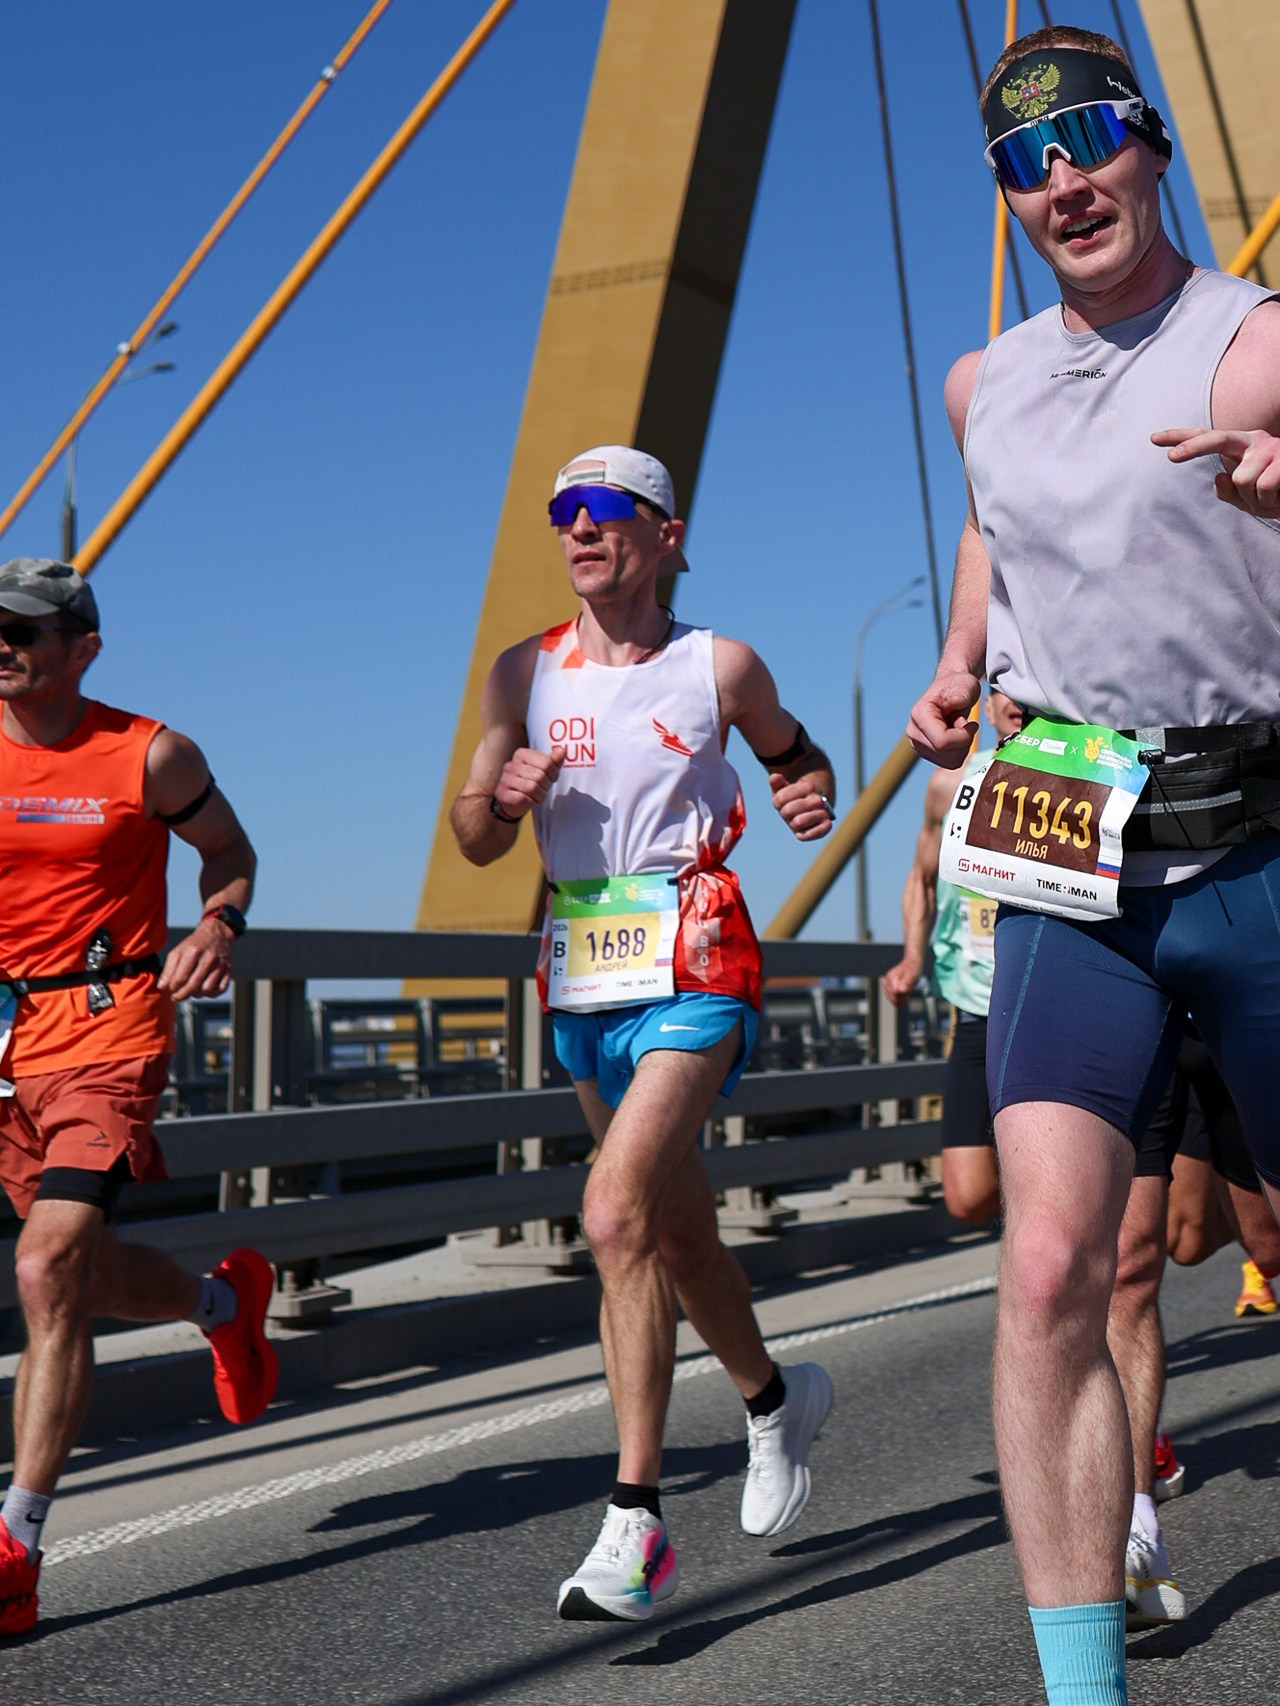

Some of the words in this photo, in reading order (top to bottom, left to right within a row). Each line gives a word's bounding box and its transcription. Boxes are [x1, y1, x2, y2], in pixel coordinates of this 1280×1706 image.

[549, 717, 595, 742] ODI
[1014, 734, 1041, 747] СБЕР
[990, 781, 1093, 850] 11343
[1015, 839, 1049, 860] ИЛЬЯ
[972, 863, 1017, 881] МАГНИТ
[586, 927, 646, 962] 1688
[594, 960, 628, 973] АНДРЕЙ
